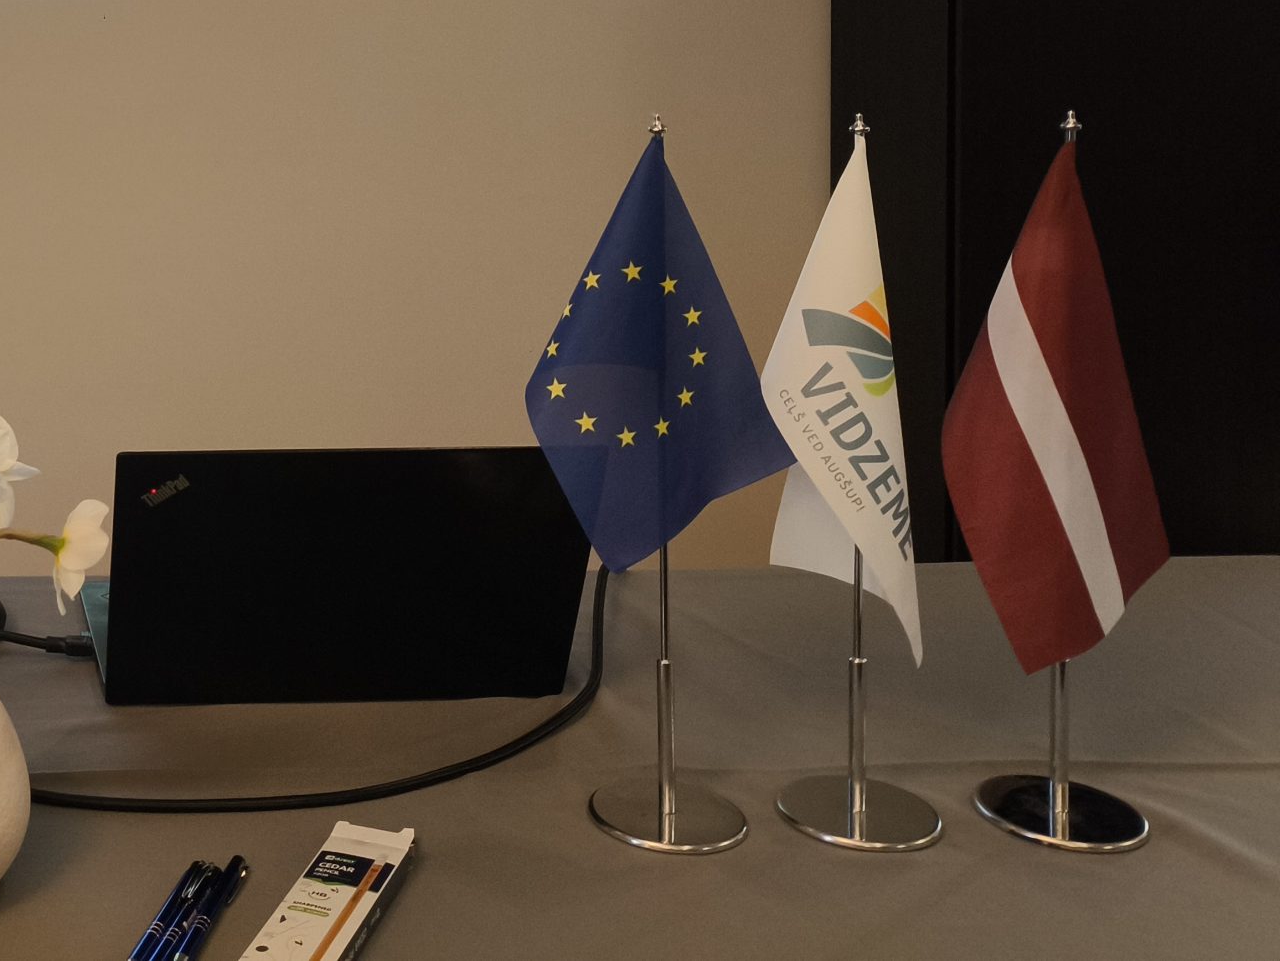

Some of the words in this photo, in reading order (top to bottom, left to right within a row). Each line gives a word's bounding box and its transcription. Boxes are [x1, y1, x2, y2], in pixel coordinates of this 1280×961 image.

[802, 423, 824, 452] VED
[141, 473, 190, 507] ThinkPad
[318, 862, 356, 873] CEDAR
